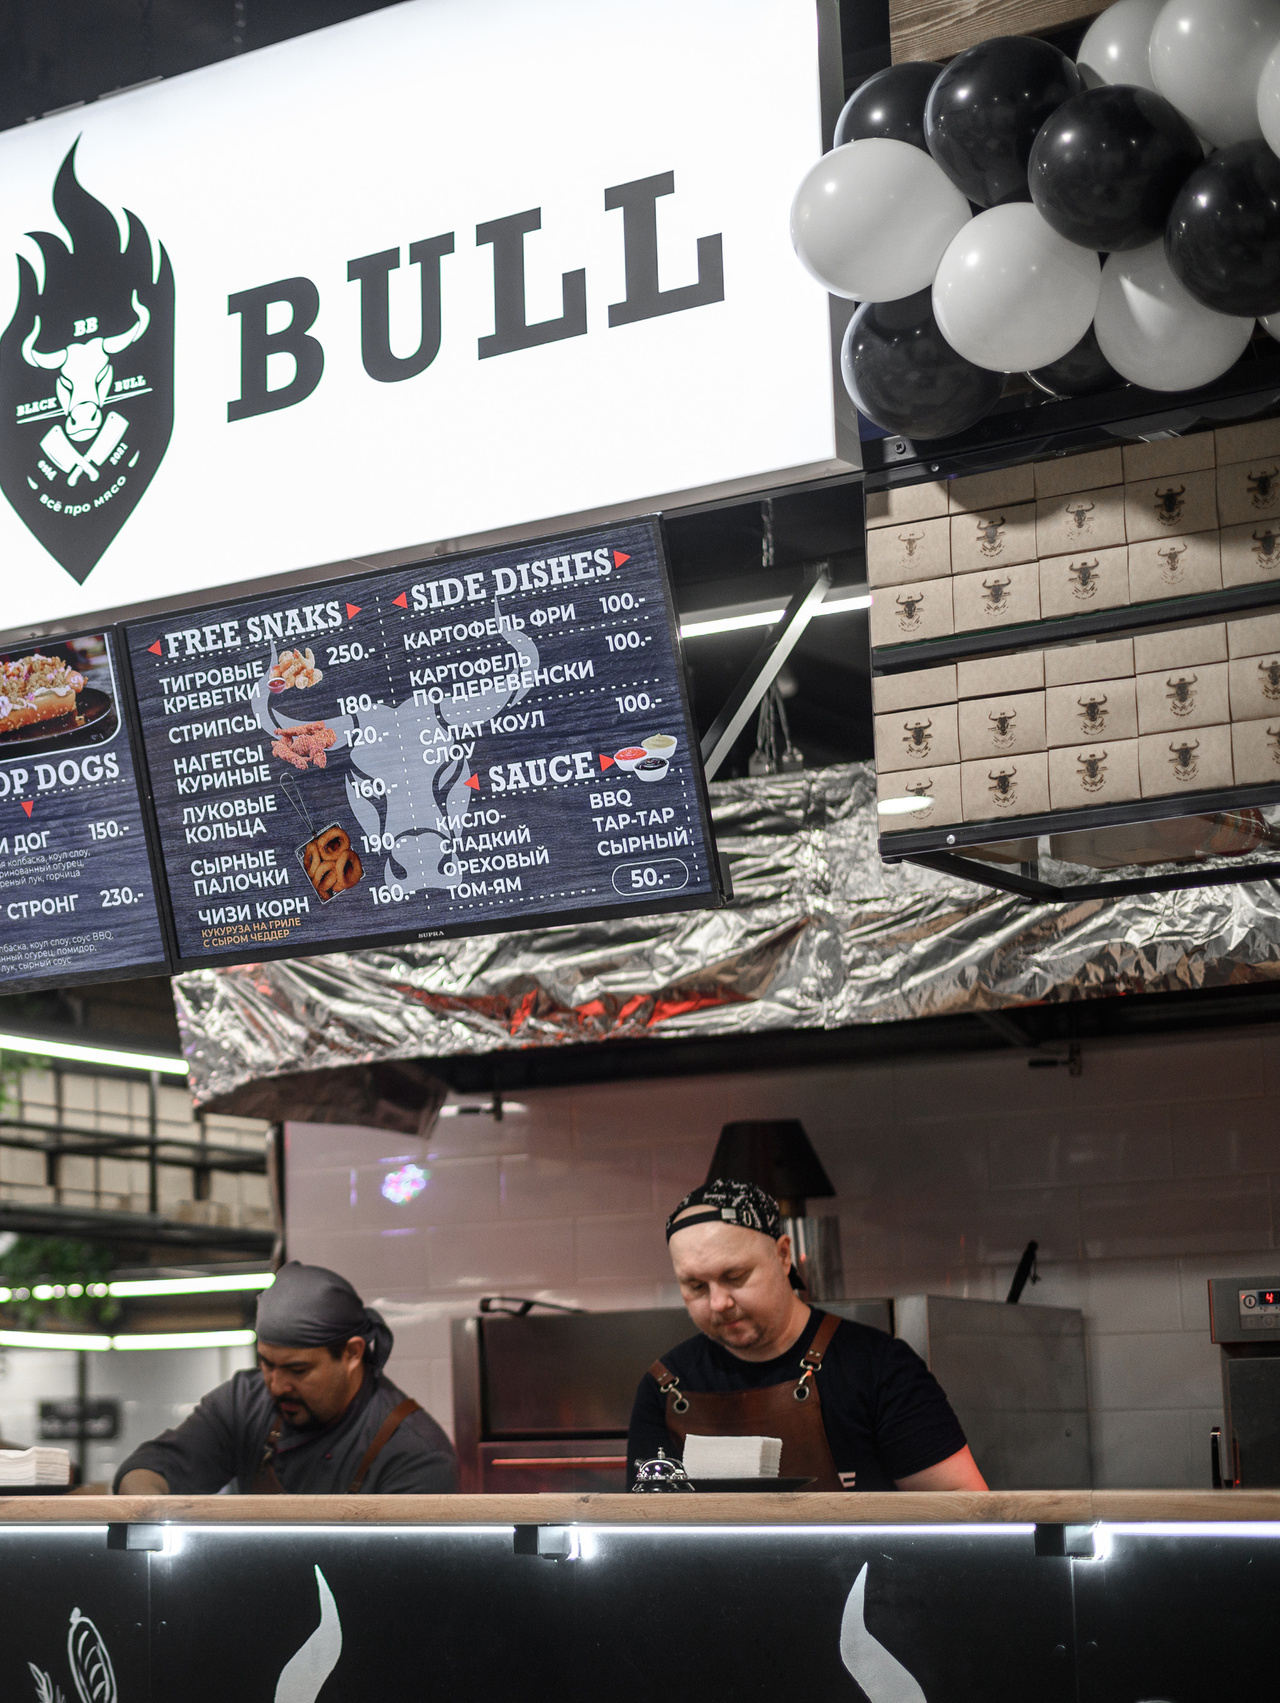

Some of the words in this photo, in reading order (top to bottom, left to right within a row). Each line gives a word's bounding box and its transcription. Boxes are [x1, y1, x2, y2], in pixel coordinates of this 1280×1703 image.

[227, 170, 725, 423] BULL
[73, 316, 99, 337] BB
[16, 397, 58, 417] BLACK
[114, 375, 147, 392] BULL
[63, 503, 91, 517] про
[411, 572, 486, 611] SIDE
[492, 548, 612, 596] DISHES
[165, 620, 242, 658] FREE
[247, 601, 343, 643] SNAKS
[403, 614, 525, 650] КАРТОФЕЛЬ
[530, 603, 576, 627] ФРИ
[159, 661, 265, 694] ТИГРОВЫЕ
[409, 652, 531, 687] КАРТОФЕЛЬ
[412, 660, 595, 707] ПО-ДЕРЕВЕНСКИ
[163, 682, 261, 715] КРЕВЕТКИ
[168, 713, 262, 744] СТРИПСЫ
[419, 720, 484, 745] САЛАТ
[490, 710, 545, 735] КОУЛ
[174, 745, 264, 775] НАГЕТСЫ
[422, 741, 475, 765] СЛОУ
[34, 752, 120, 790] DOGS
[177, 765, 271, 795] КУРИНЫЕ
[489, 751, 595, 792] SAUCE
[182, 795, 278, 825] ЛУКОВЫЕ
[590, 789, 633, 809] BBQ
[185, 817, 267, 844] КОЛЬЦА
[436, 809, 507, 831] КИСЛО-
[593, 807, 675, 833] ТАР-ТАР
[14, 831, 51, 856] ДОГ
[440, 825, 532, 854] СЛАДКИЙ
[597, 826, 689, 856] СЫРНЫЙ
[190, 849, 277, 877] СЫРНЫЕ
[443, 846, 550, 877] ОРЕХОВЫЙ
[194, 868, 289, 897] ПАЛОЧКИ
[447, 877, 522, 900] ТОМ-ЯМ
[7, 894, 79, 920] СТРОНГ
[198, 904, 251, 925] ЧИЗИ
[256, 896, 310, 919] КОРН
[201, 924, 250, 938] КУКУРУЗА
[269, 917, 301, 929] ГРИЛЕ
[203, 939, 210, 948] С
[212, 934, 248, 947] СЫРОМ
[251, 929, 290, 942] ЧЕДДЕР
